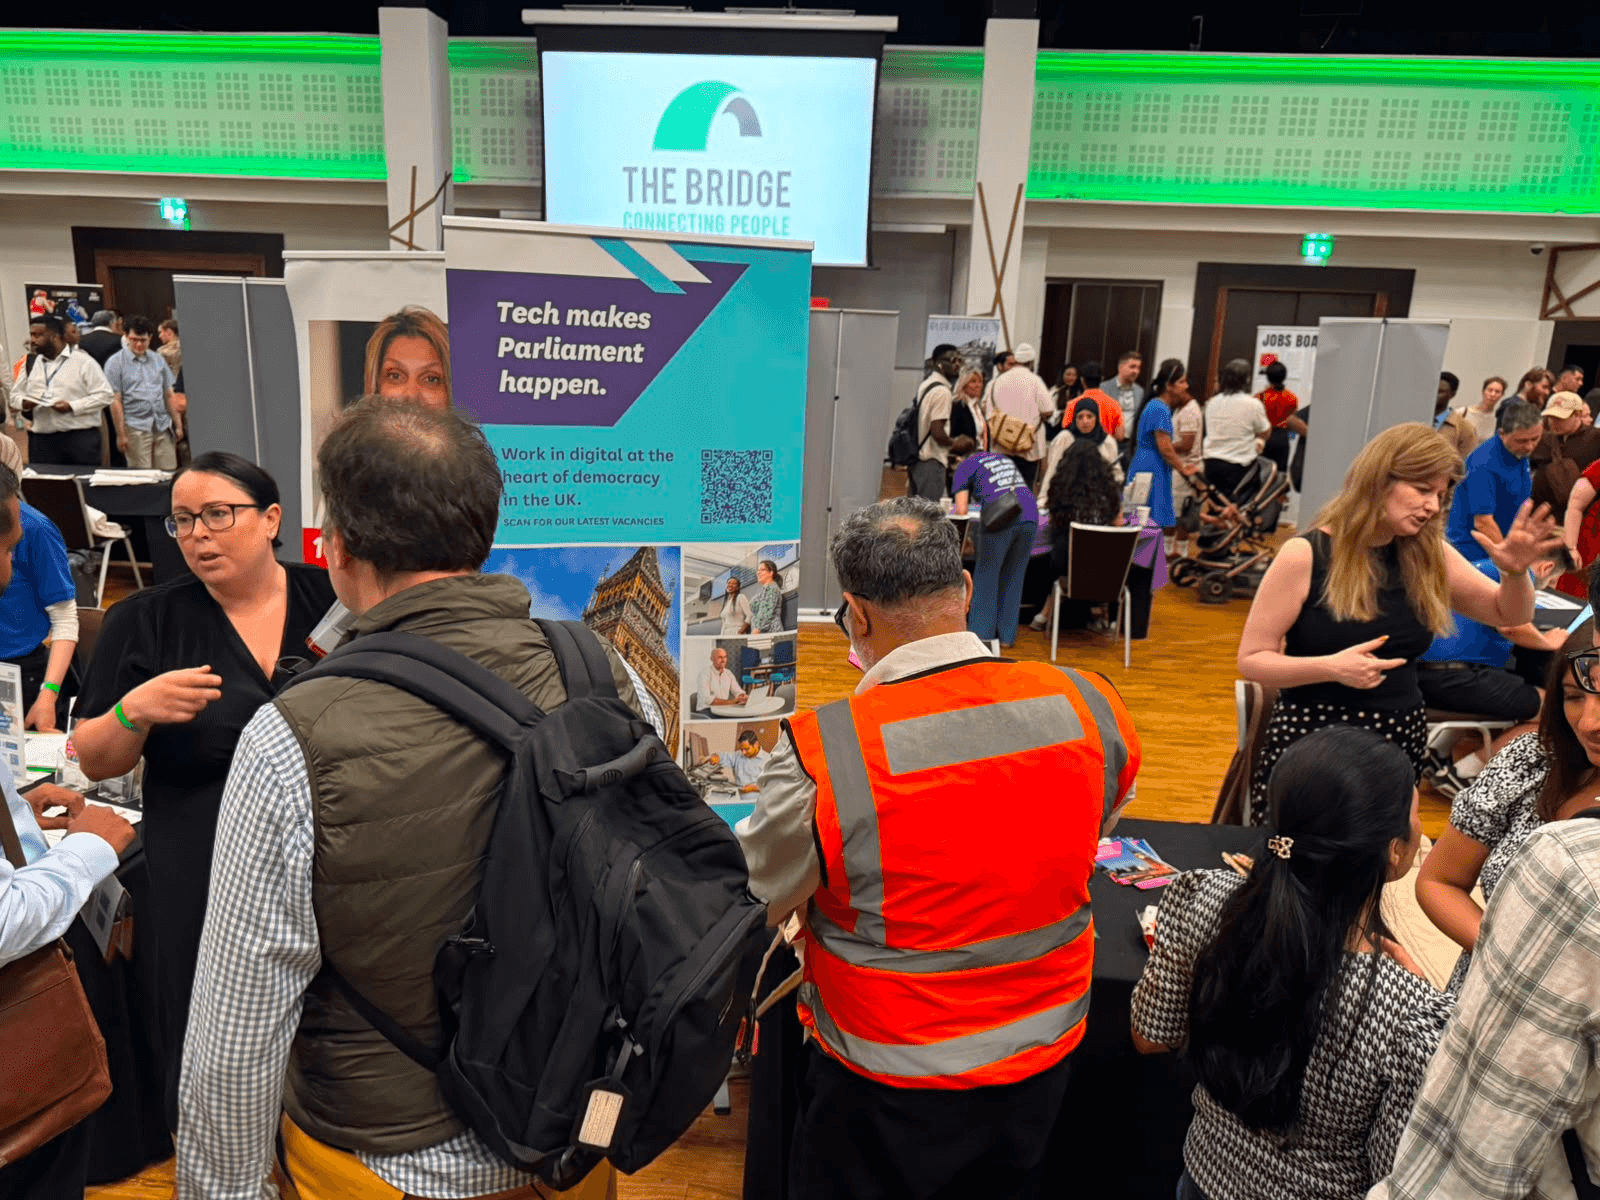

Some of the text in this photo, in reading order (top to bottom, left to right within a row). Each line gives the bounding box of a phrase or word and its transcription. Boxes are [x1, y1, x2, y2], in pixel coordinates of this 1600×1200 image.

[622, 166, 791, 208] THE BRIDGE
[623, 211, 790, 236] CONNECTING PEOPLE
[497, 301, 651, 329] Tech makes
[497, 336, 645, 363] Parliament
[1262, 334, 1292, 347] JOBS
[499, 369, 607, 400] happen.
[502, 447, 675, 464] Work in digital at the
[502, 470, 661, 487] heart of democracy
[503, 492, 581, 506] in the UK.
[503, 517, 665, 527] SCAN FOR OUR LATEST VACANCIES
